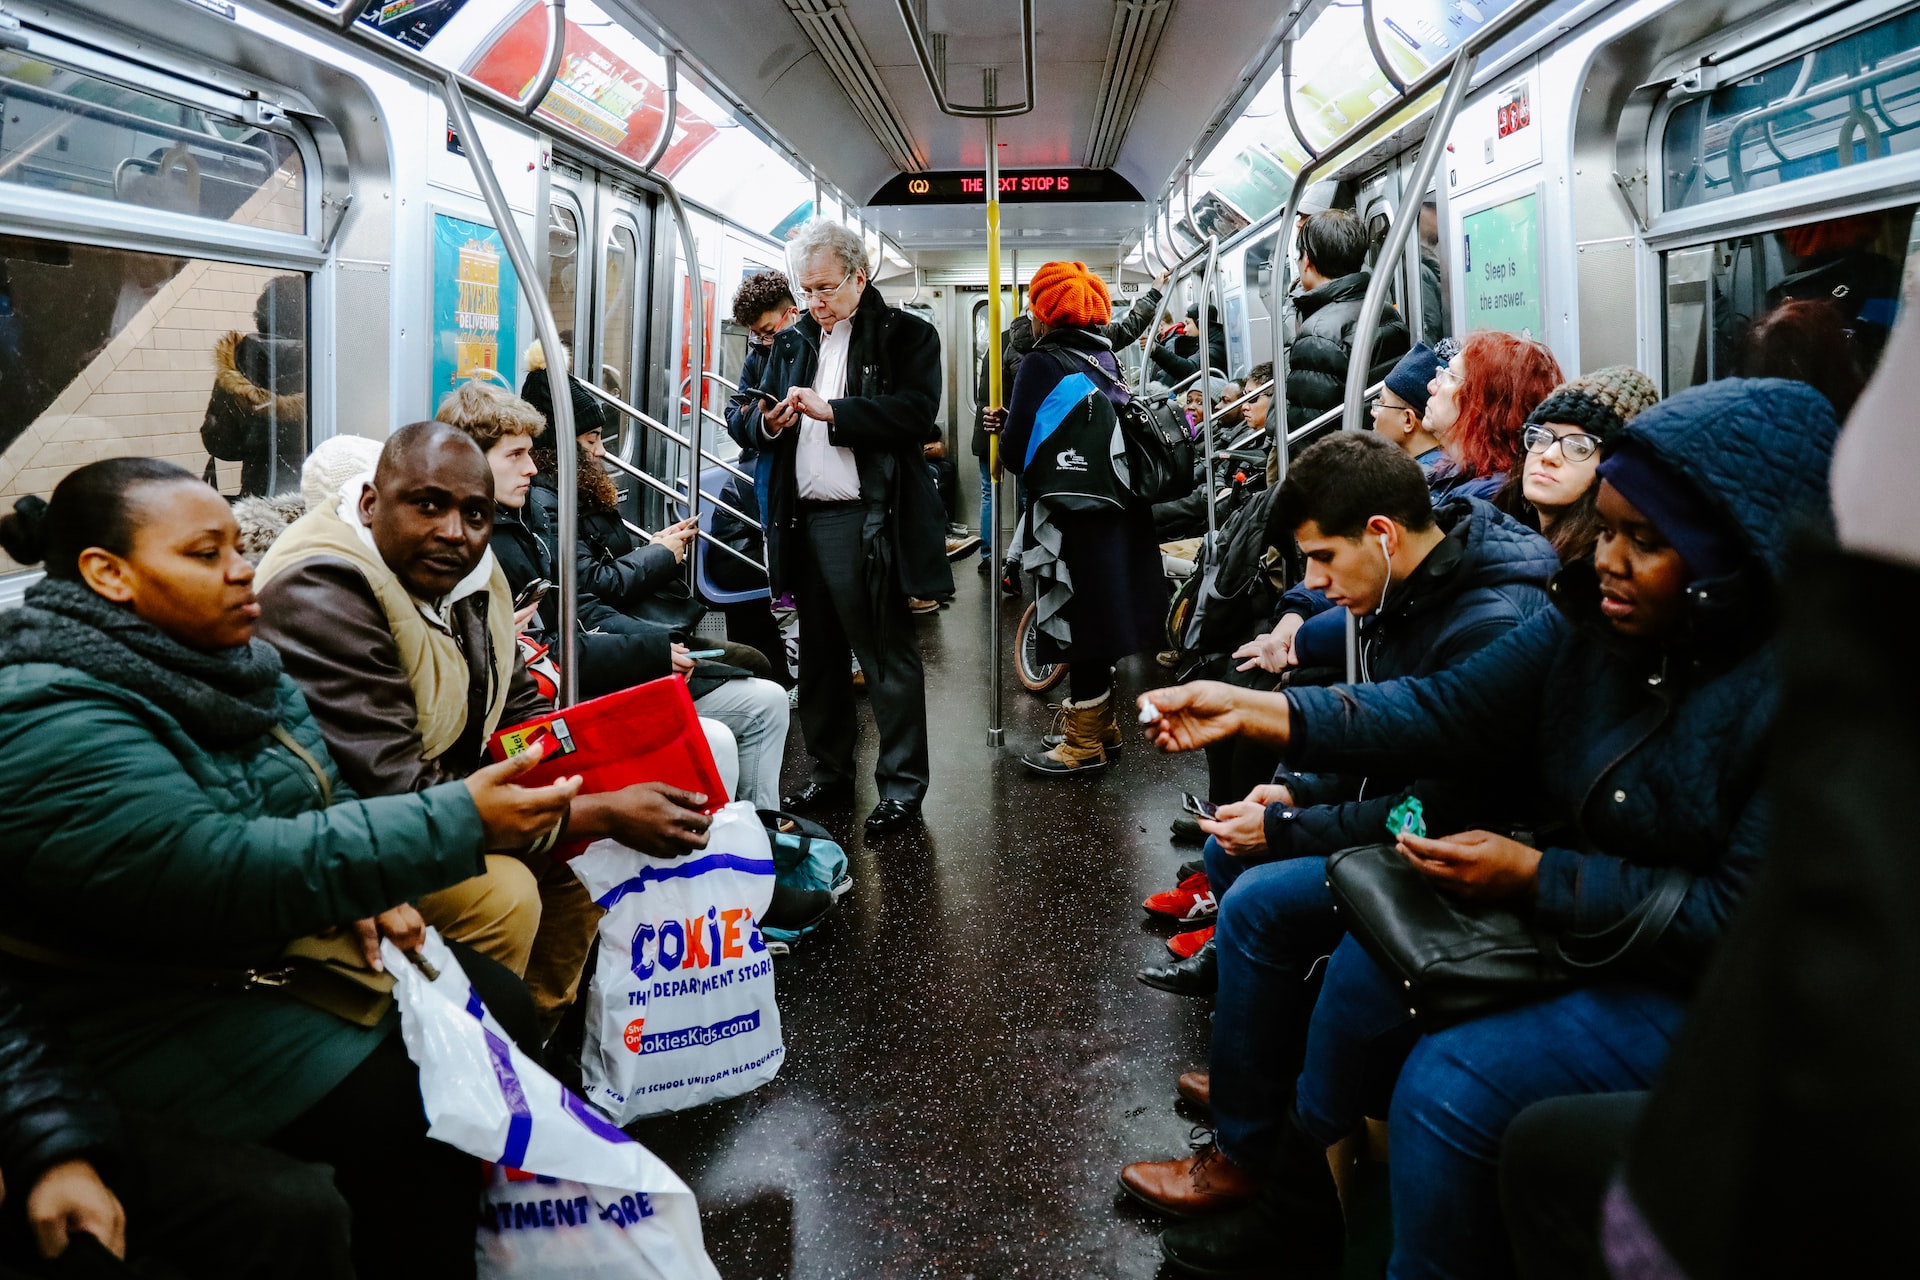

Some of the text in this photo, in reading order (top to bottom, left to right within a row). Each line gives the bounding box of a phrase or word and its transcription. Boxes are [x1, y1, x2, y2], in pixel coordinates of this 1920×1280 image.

[960, 178, 983, 192] THE
[996, 177, 1018, 191] EXT
[1021, 177, 1054, 191] STOP
[1057, 176, 1069, 190] IS
[1485, 256, 1516, 283] Sleep is
[1480, 291, 1526, 310] the answer.
[460, 314, 499, 331] DELIVERING
[649, 1079, 685, 1094] SCHOOL
[687, 1069, 729, 1085] UNIFORM
